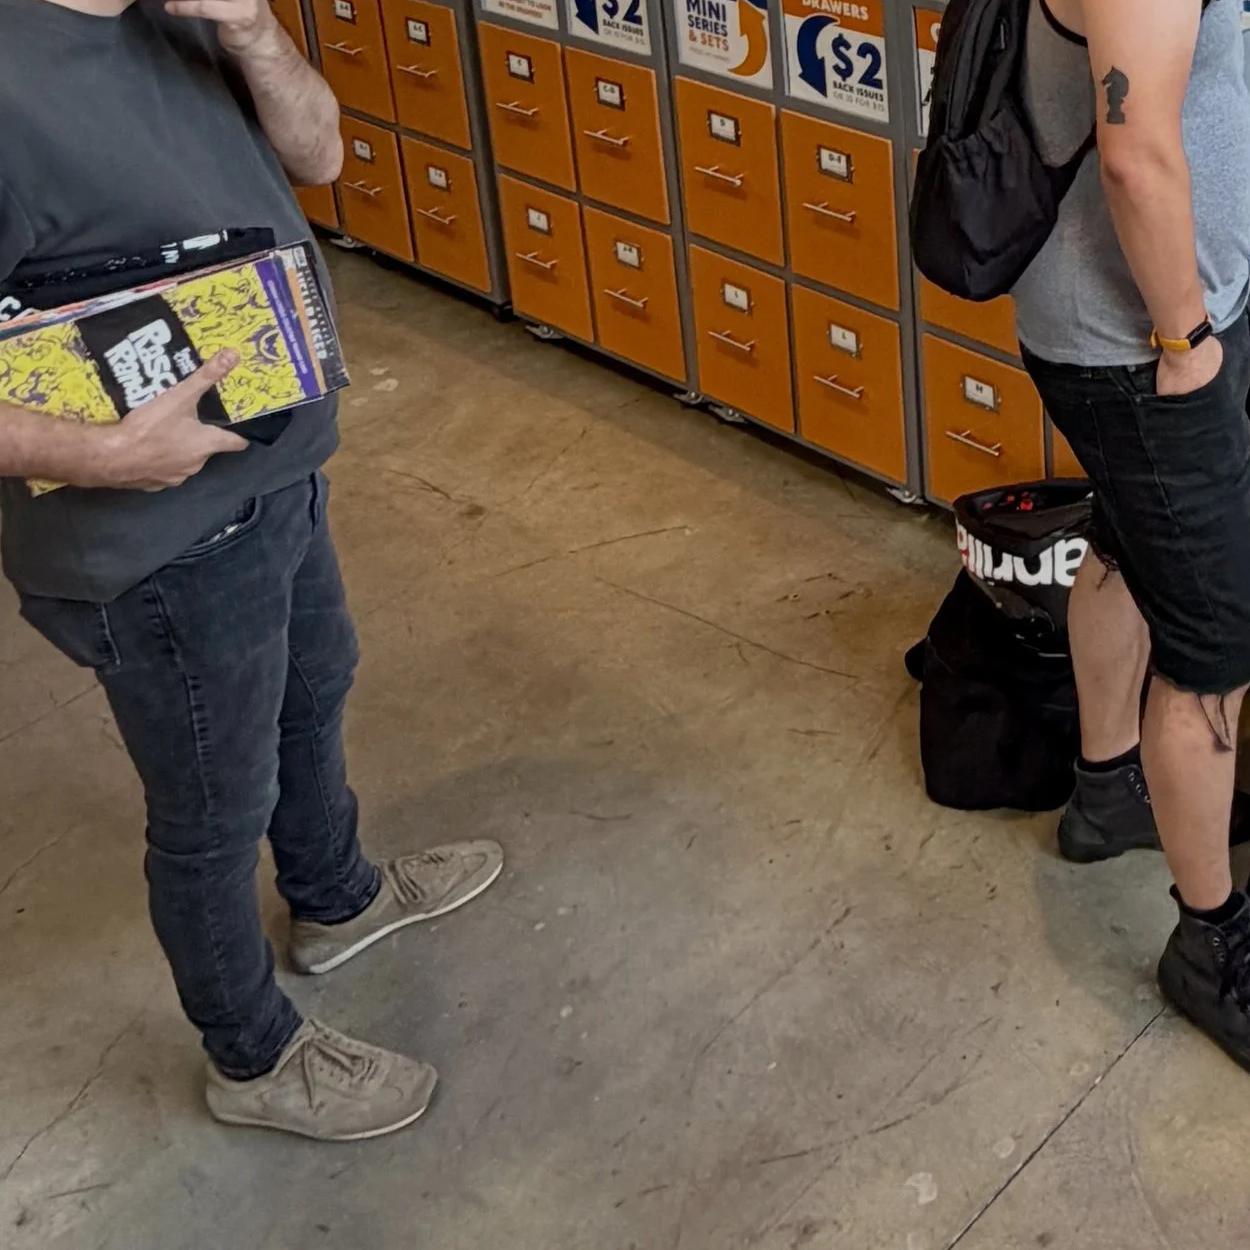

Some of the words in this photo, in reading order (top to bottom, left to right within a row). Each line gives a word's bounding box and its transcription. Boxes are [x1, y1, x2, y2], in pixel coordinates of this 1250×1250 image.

[602, 18, 620, 30] BACK
[622, 24, 644, 36] ISSUES
[687, 14, 728, 37] SERIES
[688, 29, 698, 42] &
[700, 32, 729, 52] SETS
[831, 32, 883, 90] $2
[833, 79, 854, 95] BACK
[856, 85, 884, 102] ISSUES
[128, 318, 177, 392] Rasc
